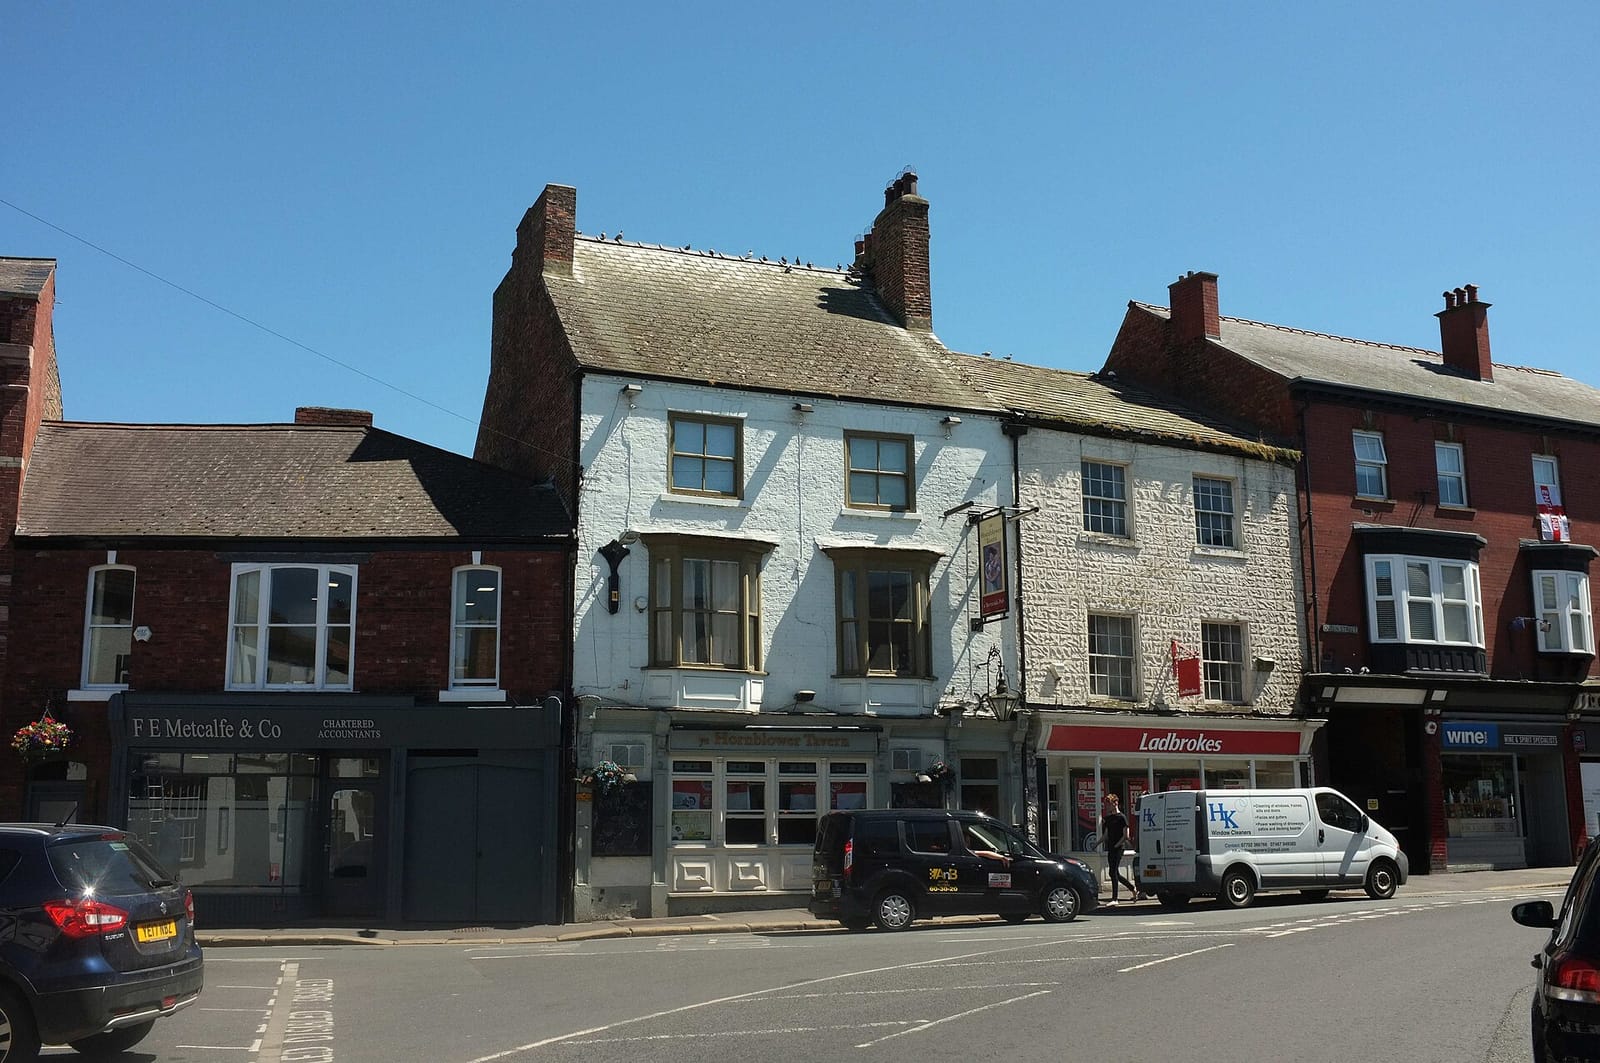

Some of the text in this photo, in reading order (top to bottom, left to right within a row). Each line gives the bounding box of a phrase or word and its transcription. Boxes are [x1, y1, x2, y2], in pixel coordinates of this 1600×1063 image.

[133, 718, 282, 738] F E Metcalfe & Co
[323, 719, 375, 728] CHARTERED
[318, 729, 381, 739] ACCOUNTANTS
[714, 731, 800, 746] Hornblower
[803, 733, 850, 747] Tavern
[1139, 732, 1222, 752] Ladbrokes
[1446, 730, 1485, 745] wine
[1143, 808, 1156, 827] HK
[1208, 803, 1239, 829] HK
